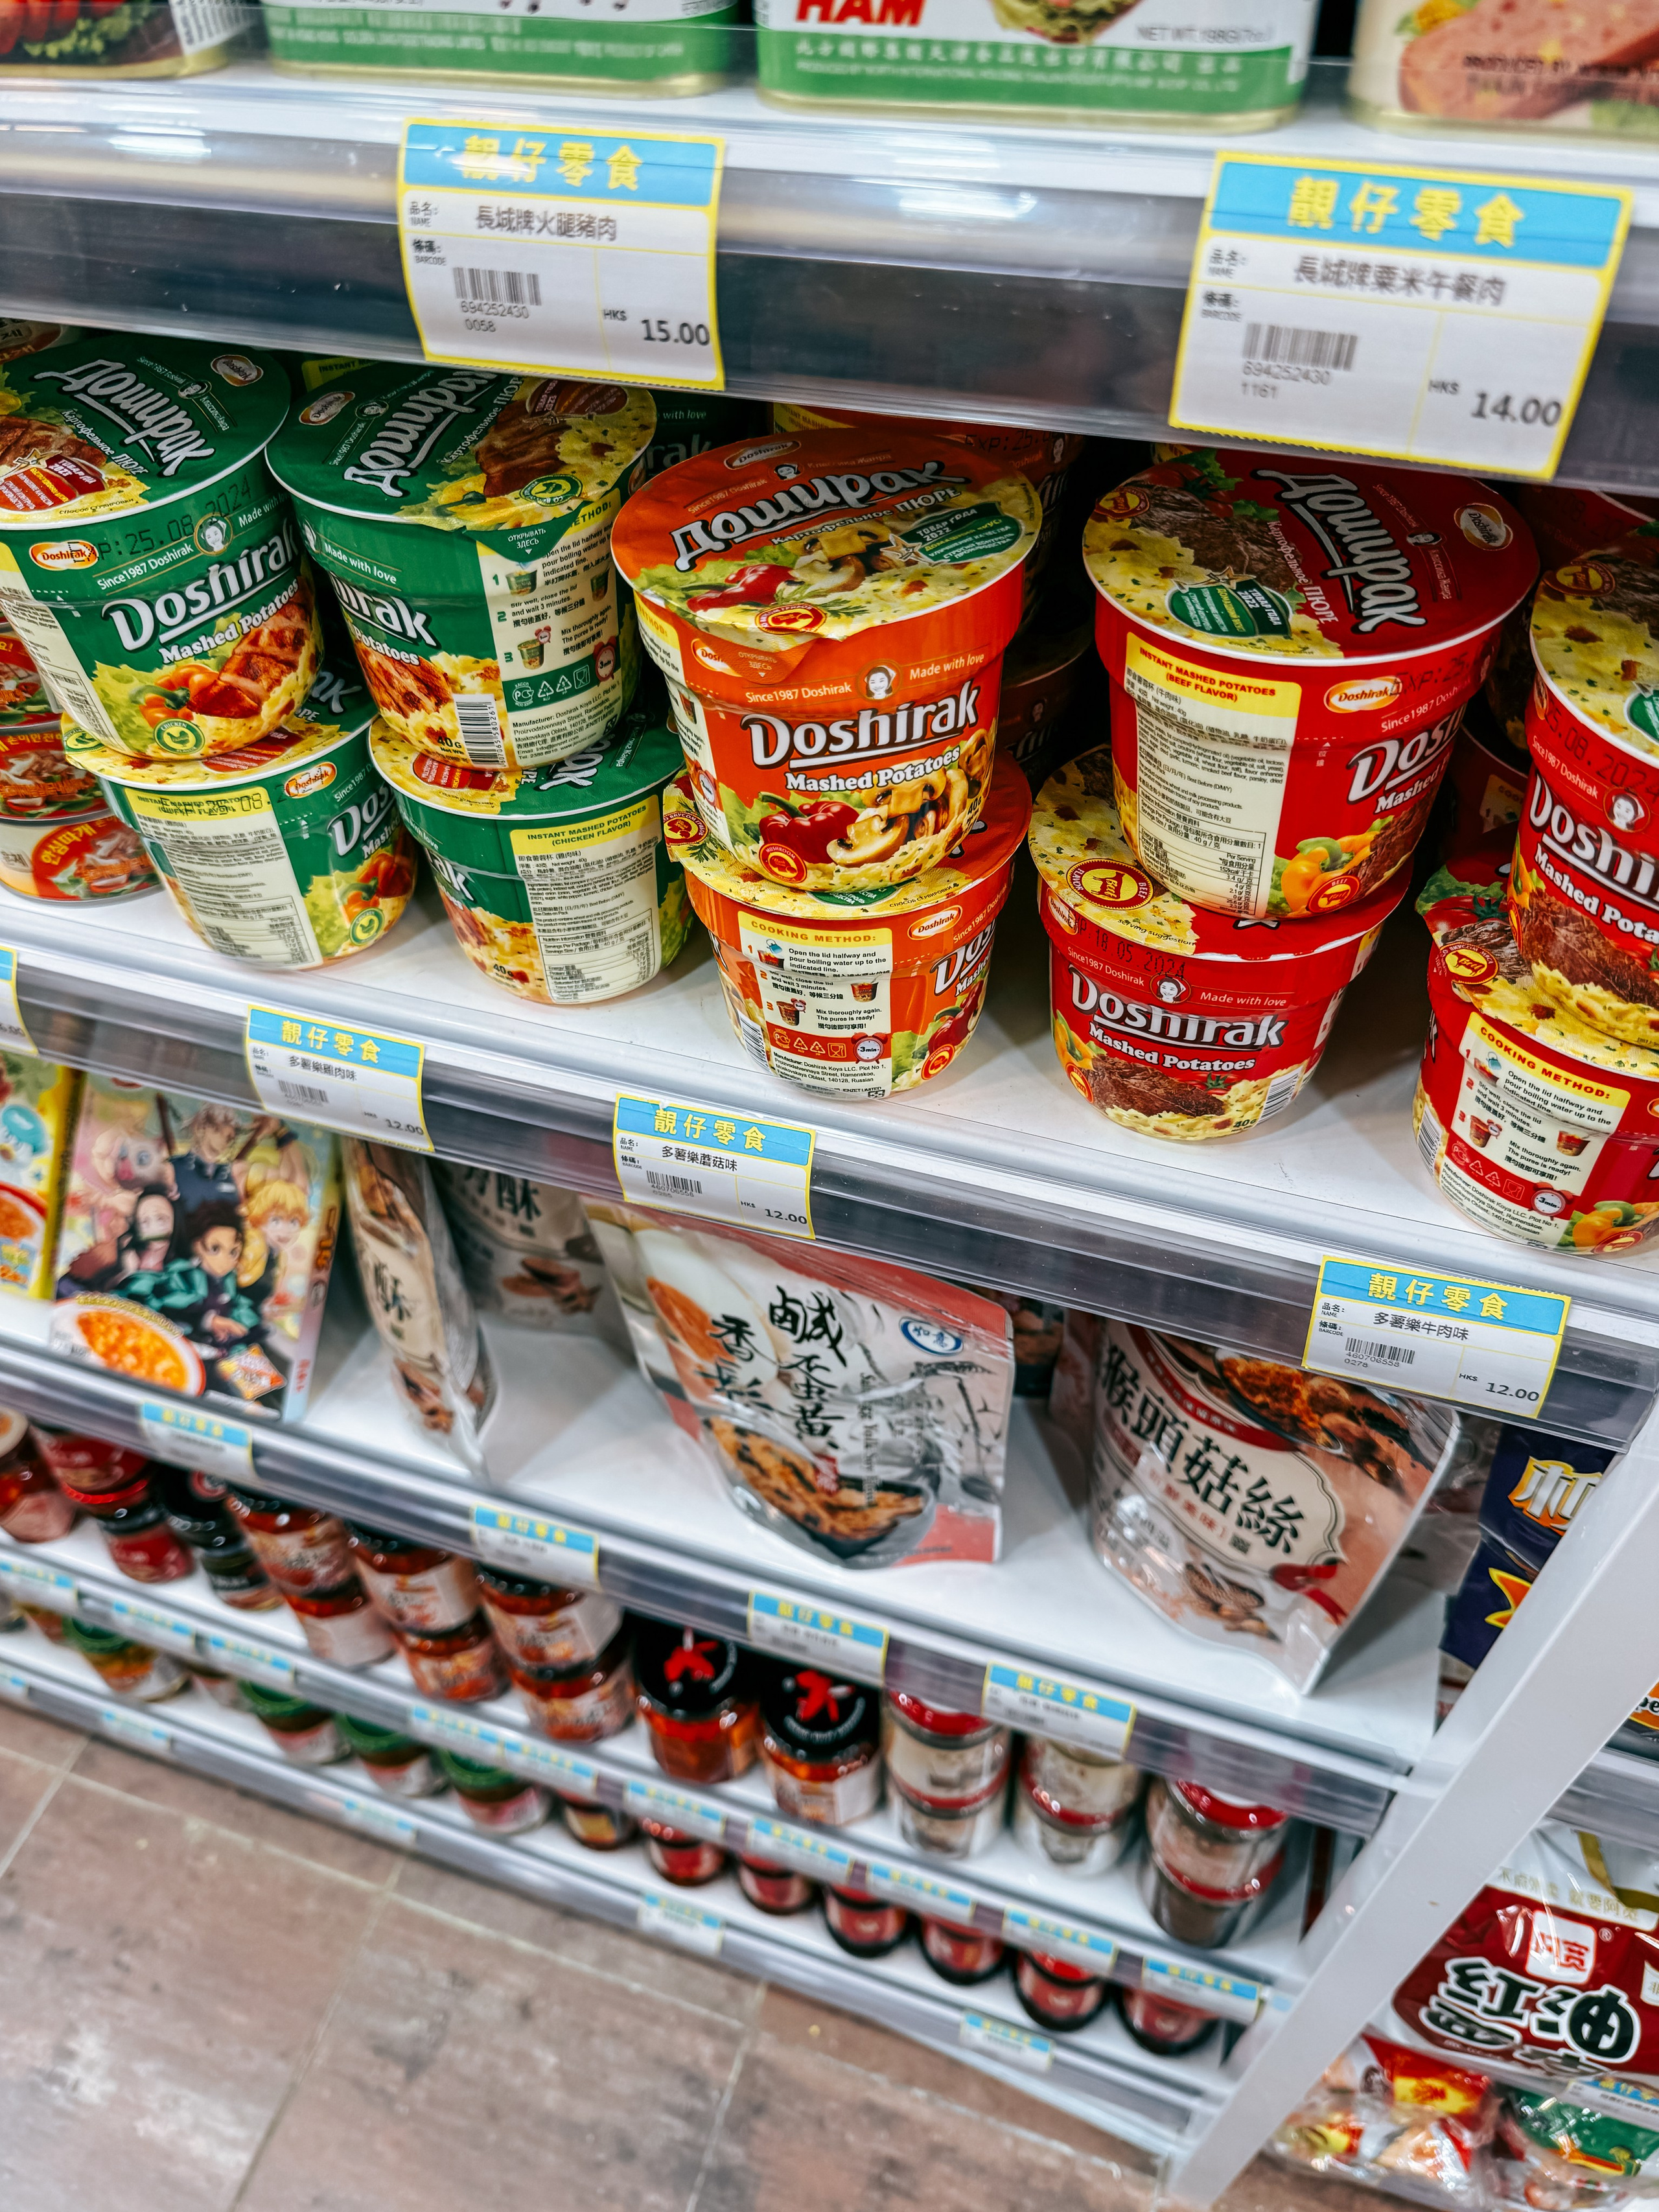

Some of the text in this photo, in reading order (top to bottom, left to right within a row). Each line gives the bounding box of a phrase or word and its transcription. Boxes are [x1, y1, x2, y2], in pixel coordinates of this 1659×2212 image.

[796, 0, 926, 27] HAM
[410, 217, 431, 227] NAME
[475, 205, 616, 240] 長城牌火腿豬肉
[1287, 177, 1525, 248] 靚仔零食
[415, 256, 447, 266] BARCODE
[461, 301, 529, 318] 694252430
[465, 319, 496, 332] 0058
[603, 309, 710, 345] HK$ 15.00
[34, 359, 214, 476] Доширак
[1472, 392, 1561, 426] 14.00
[238, 509, 262, 528] Made
[669, 461, 971, 572] Доширак
[771, 485, 962, 546] Картофельное ПЮРЕ
[916, 521, 947, 537] ТОВАР
[508, 528, 546, 542] ОТКРЫВАТЬ
[516, 539, 539, 549] ЗДЕСЬ
[923, 528, 952, 542] 2022
[324, 542, 397, 584] Made with love
[542, 549, 582, 569] pour boiling
[1253, 469, 1426, 633] Доширак
[98, 543, 194, 590] Since1987 Doshirak
[544, 561, 574, 577] indicated
[101, 522, 299, 652] Doshirak
[159, 578, 299, 665] Mashed Potatoes
[572, 612, 599, 632] thoroughly
[354, 627, 420, 666] Potatoes
[745, 652, 984, 704] Since1987 Doshirak Made with love
[1140, 647, 1276, 697] INSTANT MASHED POTATOES
[1166, 673, 1238, 703] (BEEF FLAVOR)
[160, 721, 187, 732] CHICKEN
[513, 716, 555, 728] Manufacturer:
[740, 681, 982, 768] Doshirak
[1380, 701, 1435, 733] Since1987
[785, 746, 961, 793] Mashed Potatoes
[1560, 763, 1599, 800] Doshirak
[1374, 764, 1437, 815] Mashed
[528, 805, 646, 840] INSTANT MASHED POTATOES
[552, 821, 631, 846] (CHICKEN FLAVOR)
[1529, 774, 1659, 901] Doshi
[1534, 843, 1599, 916] Mashed
[751, 921, 808, 940] COOKING
[917, 913, 956, 937] Doshirak
[953, 911, 986, 944] Since1987
[1117, 918, 1148, 935] serving
[790, 962, 822, 972] indicated
[833, 951, 860, 959] halfway
[1067, 946, 1287, 1008] Since1987 Doshirak Made with love
[1068, 964, 1290, 1049] Doshirak
[281, 1020, 381, 1064] 靚仔零食
[1088, 1022, 1256, 1072] Mashed Potatoes
[804, 1061, 827, 1071] Doshirak
[1480, 1027, 1610, 1099] COOKING METHOD:
[1503, 1084, 1536, 1106] indicated
[1505, 1078, 1573, 1113] pour boiling water
[1508, 1071, 1603, 1115] Open halfway and
[385, 1119, 424, 1135] 12.00
[654, 1109, 767, 1152] 靚仔零食
[1505, 1107, 1532, 1128] minutes.
[662, 1146, 738, 1171] 多薯樂蘑菇味
[1507, 1147, 1539, 1165] The puree
[1522, 1147, 1582, 1172] thoroughly again.
[1471, 1186, 1496, 1204] Doshirak
[765, 1209, 807, 1224] 12.00
[1321, 1303, 1345, 1314] 品名:
[1367, 1273, 1509, 1320] 靚仔零食
[1318, 1327, 1343, 1337] BARCODE
[1373, 1312, 1470, 1342] 多薯樂牛肉味
[1344, 1358, 1369, 1368] 0278
[1345, 1351, 1400, 1368] 460706558
[1485, 1382, 1540, 1402] 12.00
[1099, 1344, 1305, 1555] 猴頭菇絲
